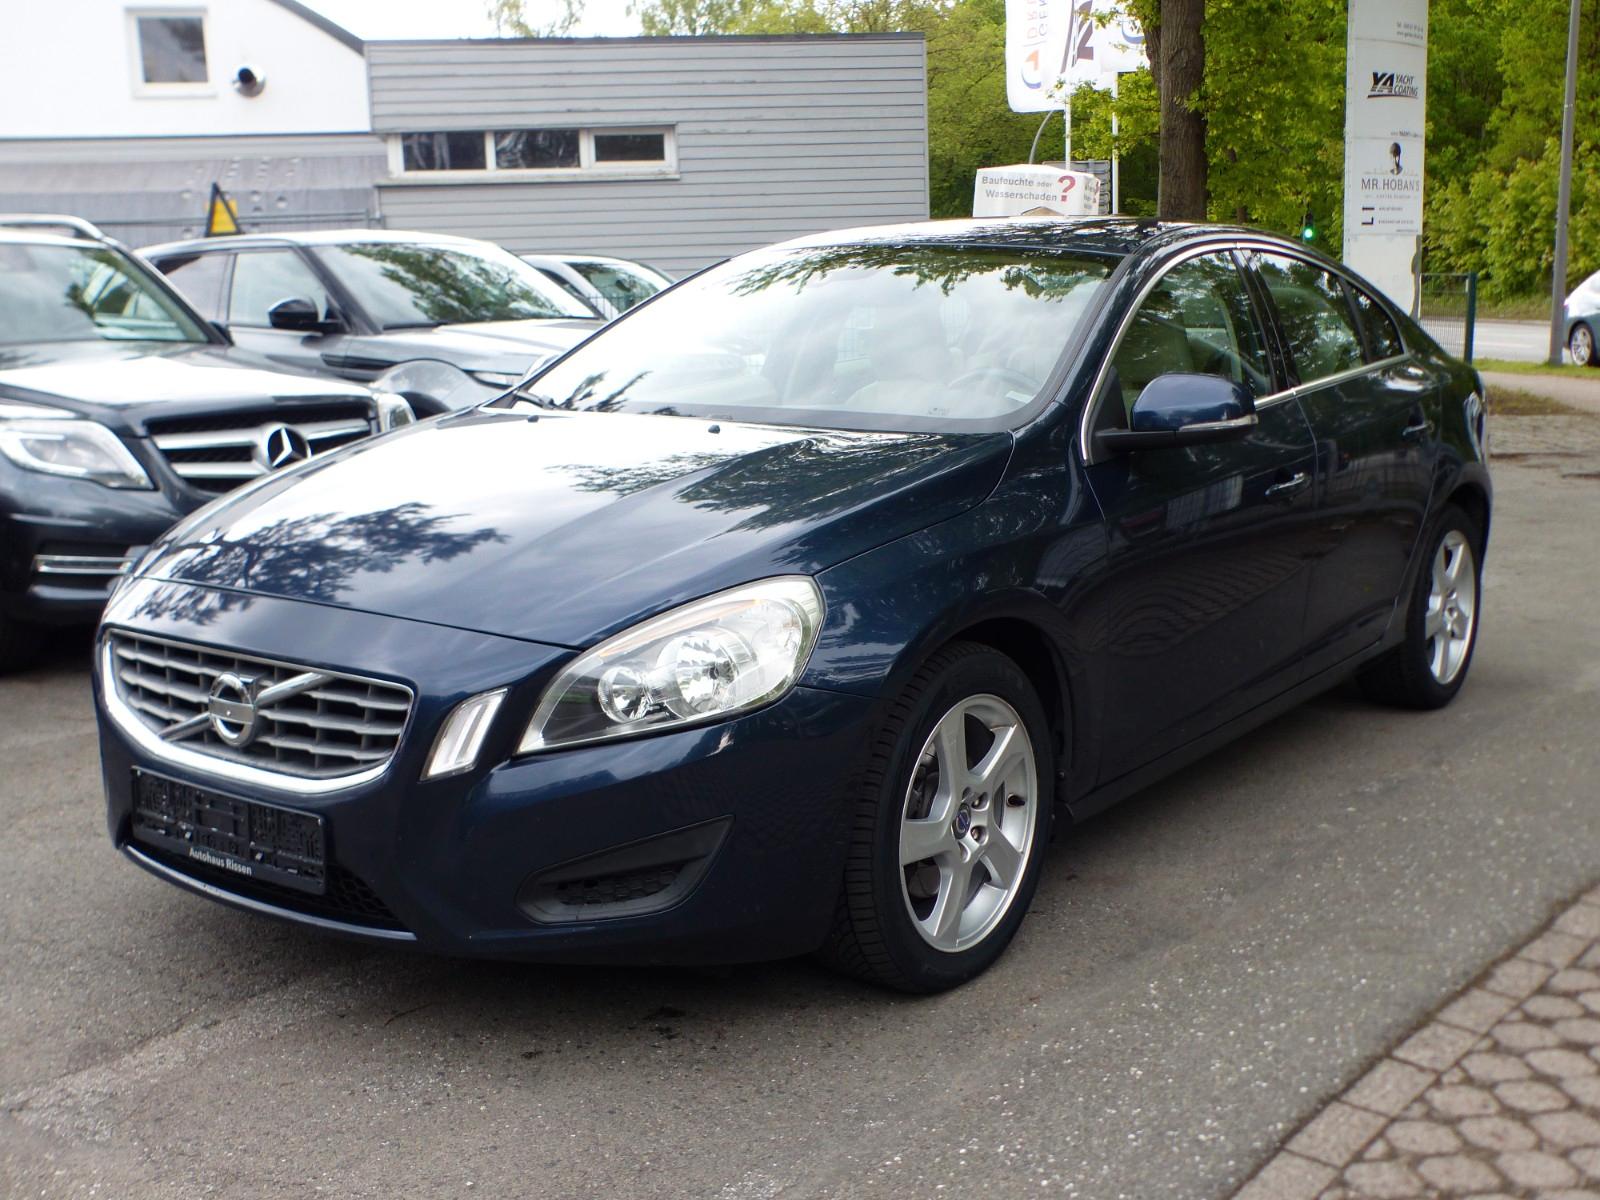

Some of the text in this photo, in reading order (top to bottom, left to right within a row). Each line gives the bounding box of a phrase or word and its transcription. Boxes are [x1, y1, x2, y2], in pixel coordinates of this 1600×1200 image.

[1395, 73, 1414, 85] YACHT
[1394, 85, 1418, 97] COATING
[985, 189, 1057, 202] Wasserschaden
[189, 847, 252, 876] Autohaus Rissen
